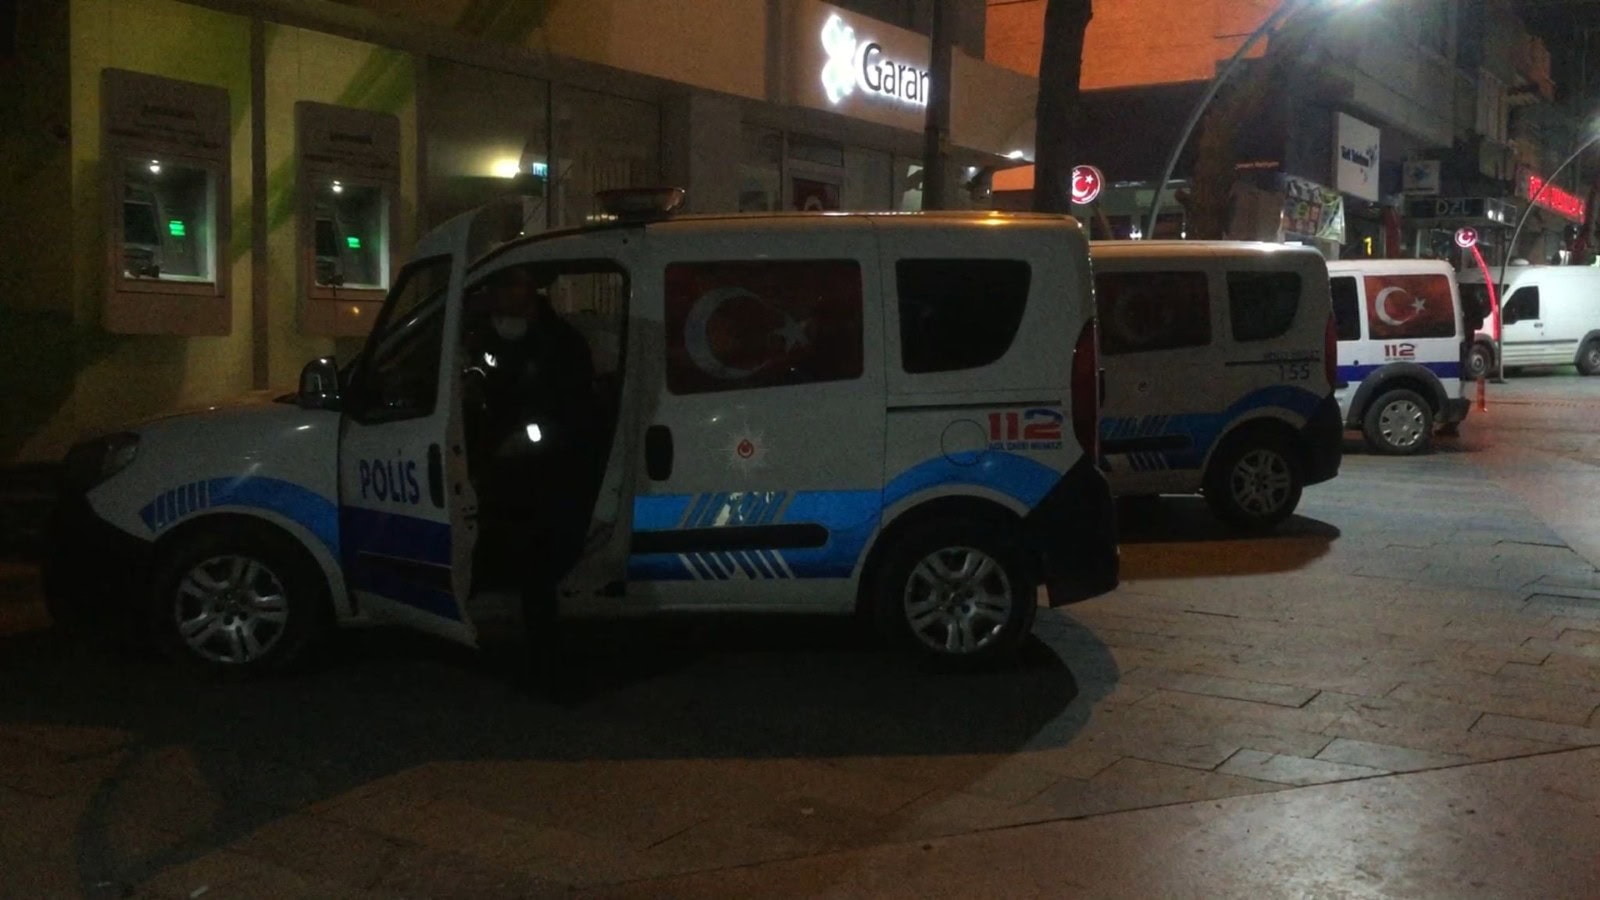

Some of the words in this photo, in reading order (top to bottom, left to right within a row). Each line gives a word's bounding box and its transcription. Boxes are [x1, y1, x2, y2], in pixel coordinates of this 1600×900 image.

[1384, 343, 1415, 356] 112
[1279, 363, 1309, 380] 155
[988, 409, 1063, 439] 112
[360, 448, 419, 504] POLİS
